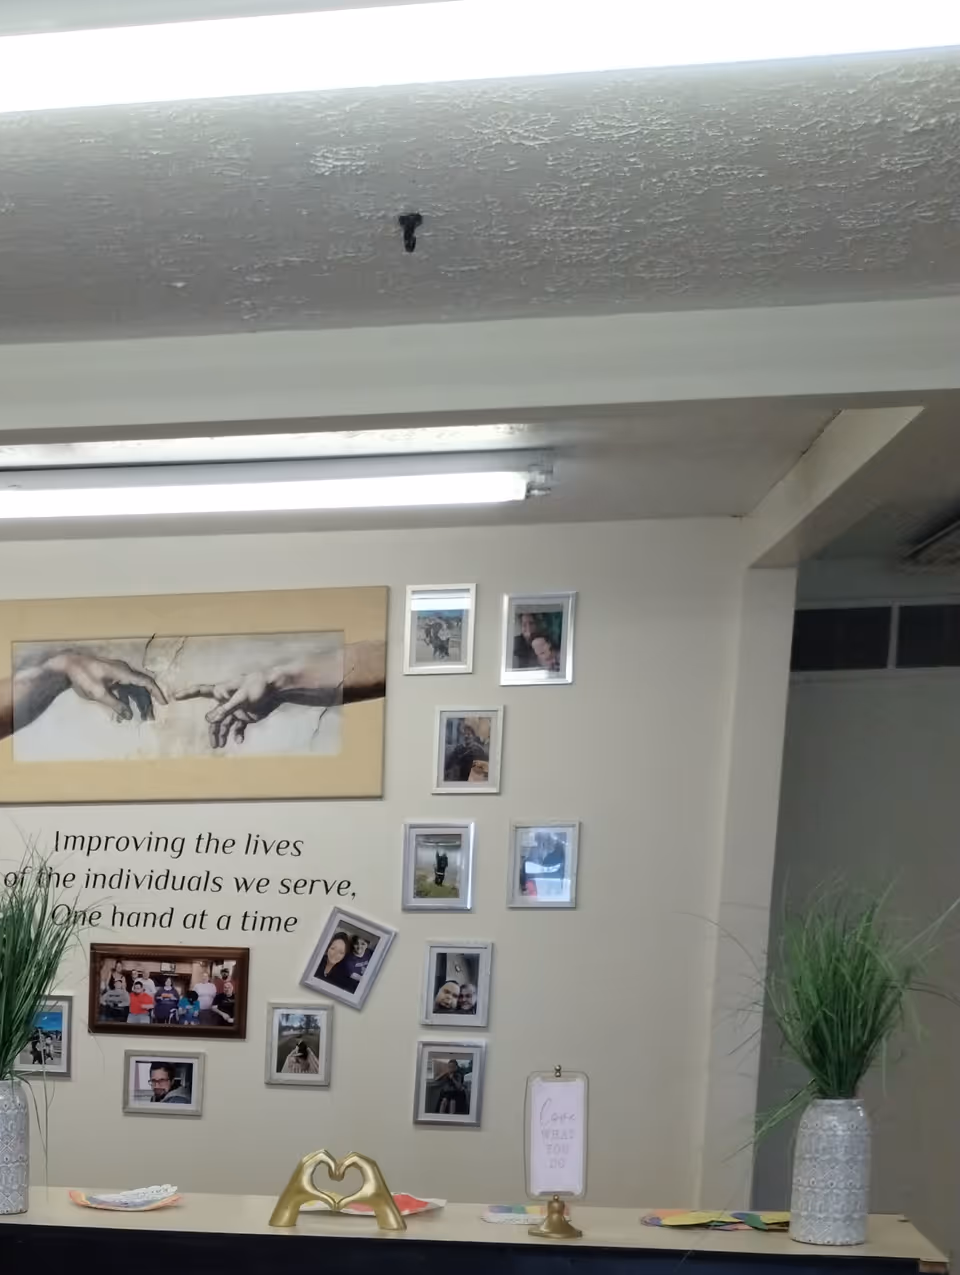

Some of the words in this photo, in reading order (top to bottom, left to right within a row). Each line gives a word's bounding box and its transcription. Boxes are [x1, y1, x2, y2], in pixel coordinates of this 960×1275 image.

[55, 830, 186, 860] Improving
[195, 832, 236, 855] the
[244, 832, 305, 857] lives
[4, 866, 32, 888] of
[84, 867, 224, 893] individuals
[233, 876, 271, 895] we
[278, 877, 356, 900] serve,
[52, 903, 102, 928] One
[111, 905, 175, 929] hand
[182, 909, 209, 931] at
[216, 914, 232, 931] a
[240, 911, 298, 933] time
